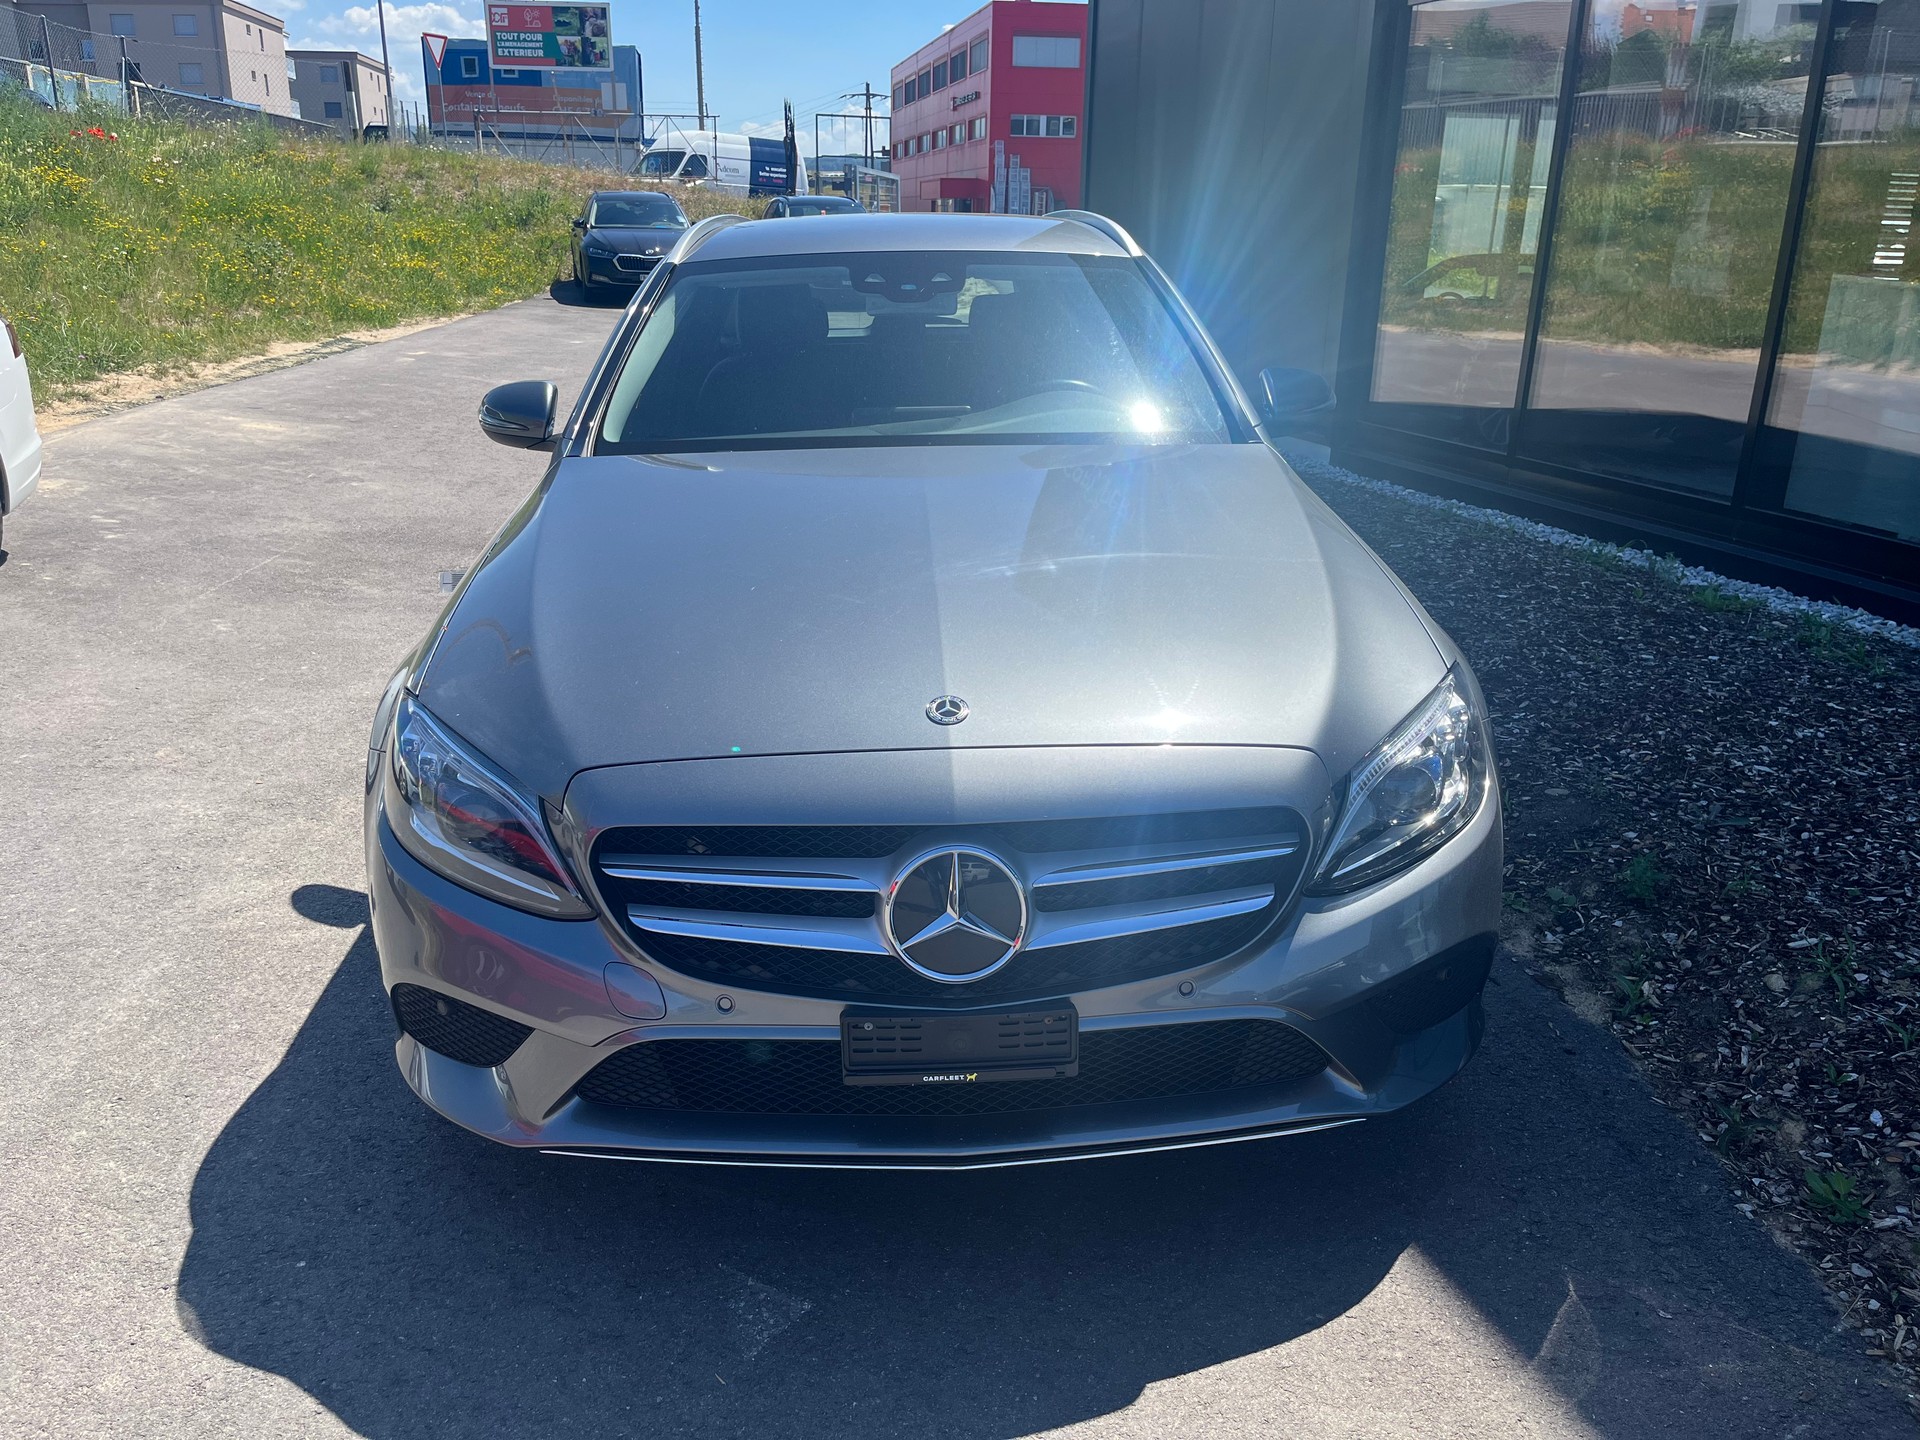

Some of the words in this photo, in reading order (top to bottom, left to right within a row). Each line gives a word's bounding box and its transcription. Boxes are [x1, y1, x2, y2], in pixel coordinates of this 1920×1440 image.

[496, 32, 519, 41] TOUT
[520, 33, 543, 42] POUR
[496, 41, 544, 49] L'AMENAGEMENT
[497, 48, 544, 57] EXTERIEUR
